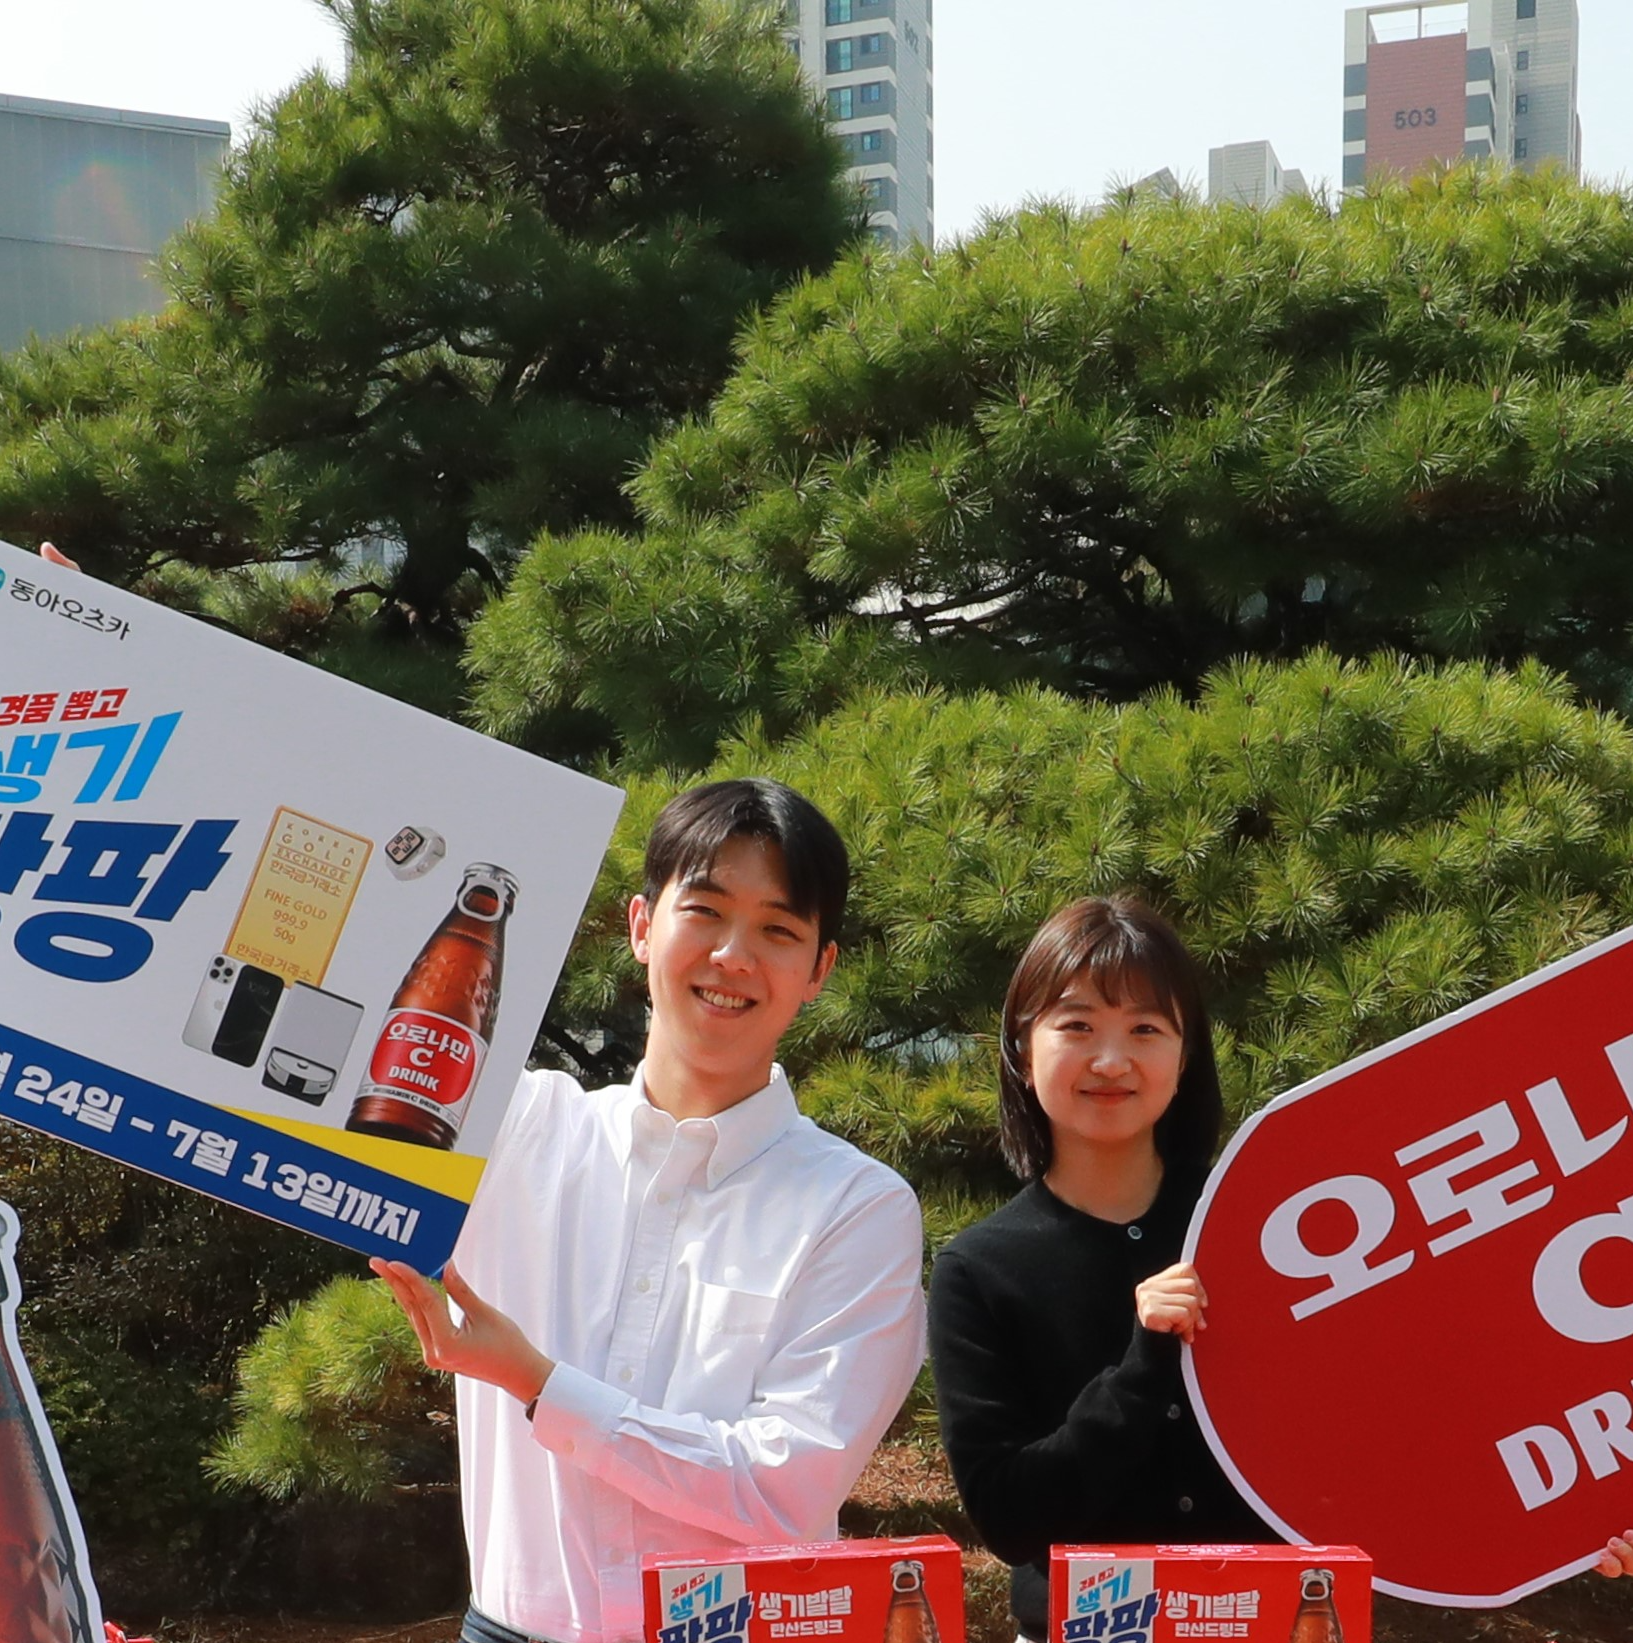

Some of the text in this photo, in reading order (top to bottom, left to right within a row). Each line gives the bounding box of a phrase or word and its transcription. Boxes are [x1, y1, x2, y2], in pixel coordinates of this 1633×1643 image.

[1394, 107, 1437, 129] 503
[10, 575, 131, 642] 동아오츠카
[60, 688, 129, 721] 뽑고
[276, 849, 350, 881] EXCHANGE
[281, 833, 352, 868] GOLD
[269, 860, 342, 898] 한국금거래소
[265, 888, 328, 920] FINE GOLD
[273, 911, 308, 931] 999.9
[273, 928, 296, 944] 50g
[236, 942, 312, 982] 한국금거래소
[386, 1022, 471, 1065] 오로나민
[410, 1048, 433, 1068] C
[388, 1066, 440, 1092] DRINK
[16, 1065, 123, 1133] 24일
[165, 1124, 239, 1176] 7월
[242, 1152, 422, 1246] 13일까지
[759, 1586, 852, 1620] 생기발랄
[1165, 1590, 1260, 1620] 생기발랄
[1175, 1622, 1248, 1638] 탄산드링크
